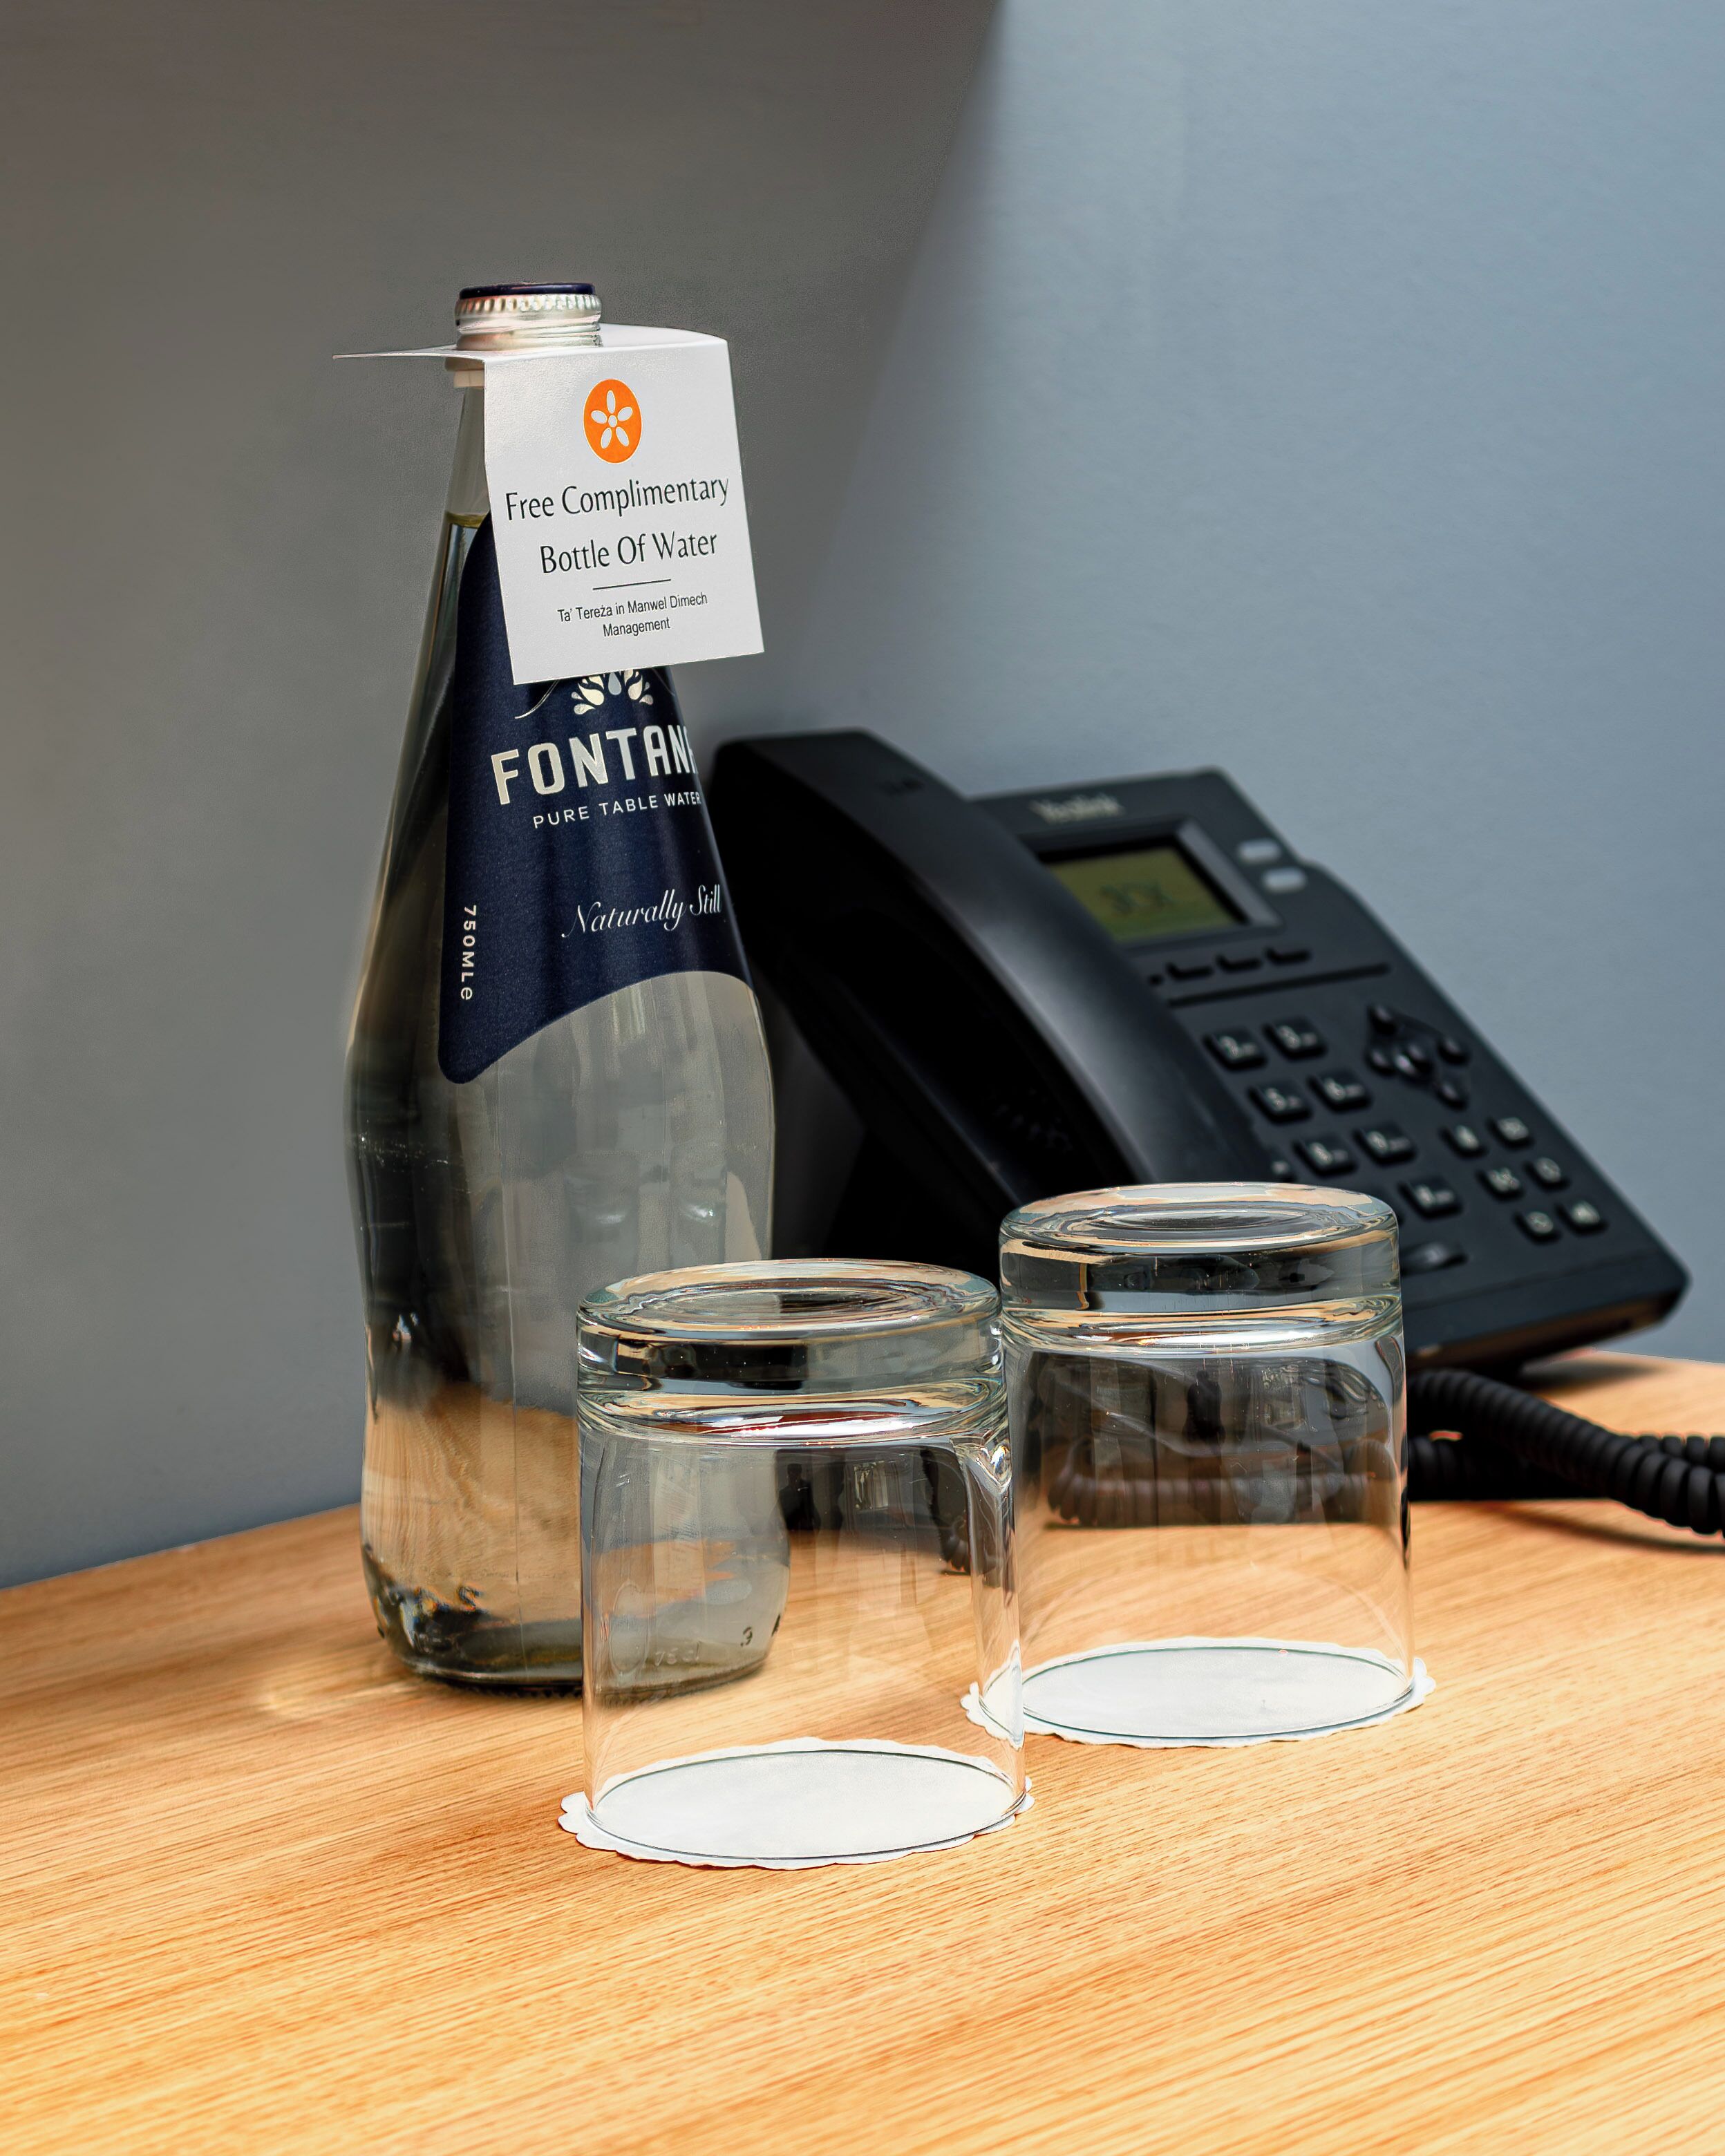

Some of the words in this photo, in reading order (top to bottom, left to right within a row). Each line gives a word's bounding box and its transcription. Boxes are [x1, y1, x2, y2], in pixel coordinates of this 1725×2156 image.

[506, 491, 554, 520] Free
[561, 477, 729, 518] Complimentary
[540, 540, 610, 574] Bottle
[617, 534, 646, 565] Of
[652, 531, 717, 561] Water
[576, 605, 613, 620] Tereża
[616, 603, 625, 614] in
[628, 596, 667, 614] Manwel
[670, 592, 708, 608] Dimech
[603, 617, 671, 637] Management
[534, 806, 590, 829] PURE
[598, 795, 659, 816] TABLE
[664, 791, 701, 807] WATER
[562, 889, 687, 938] Naturally
[690, 884, 722, 916] Still
